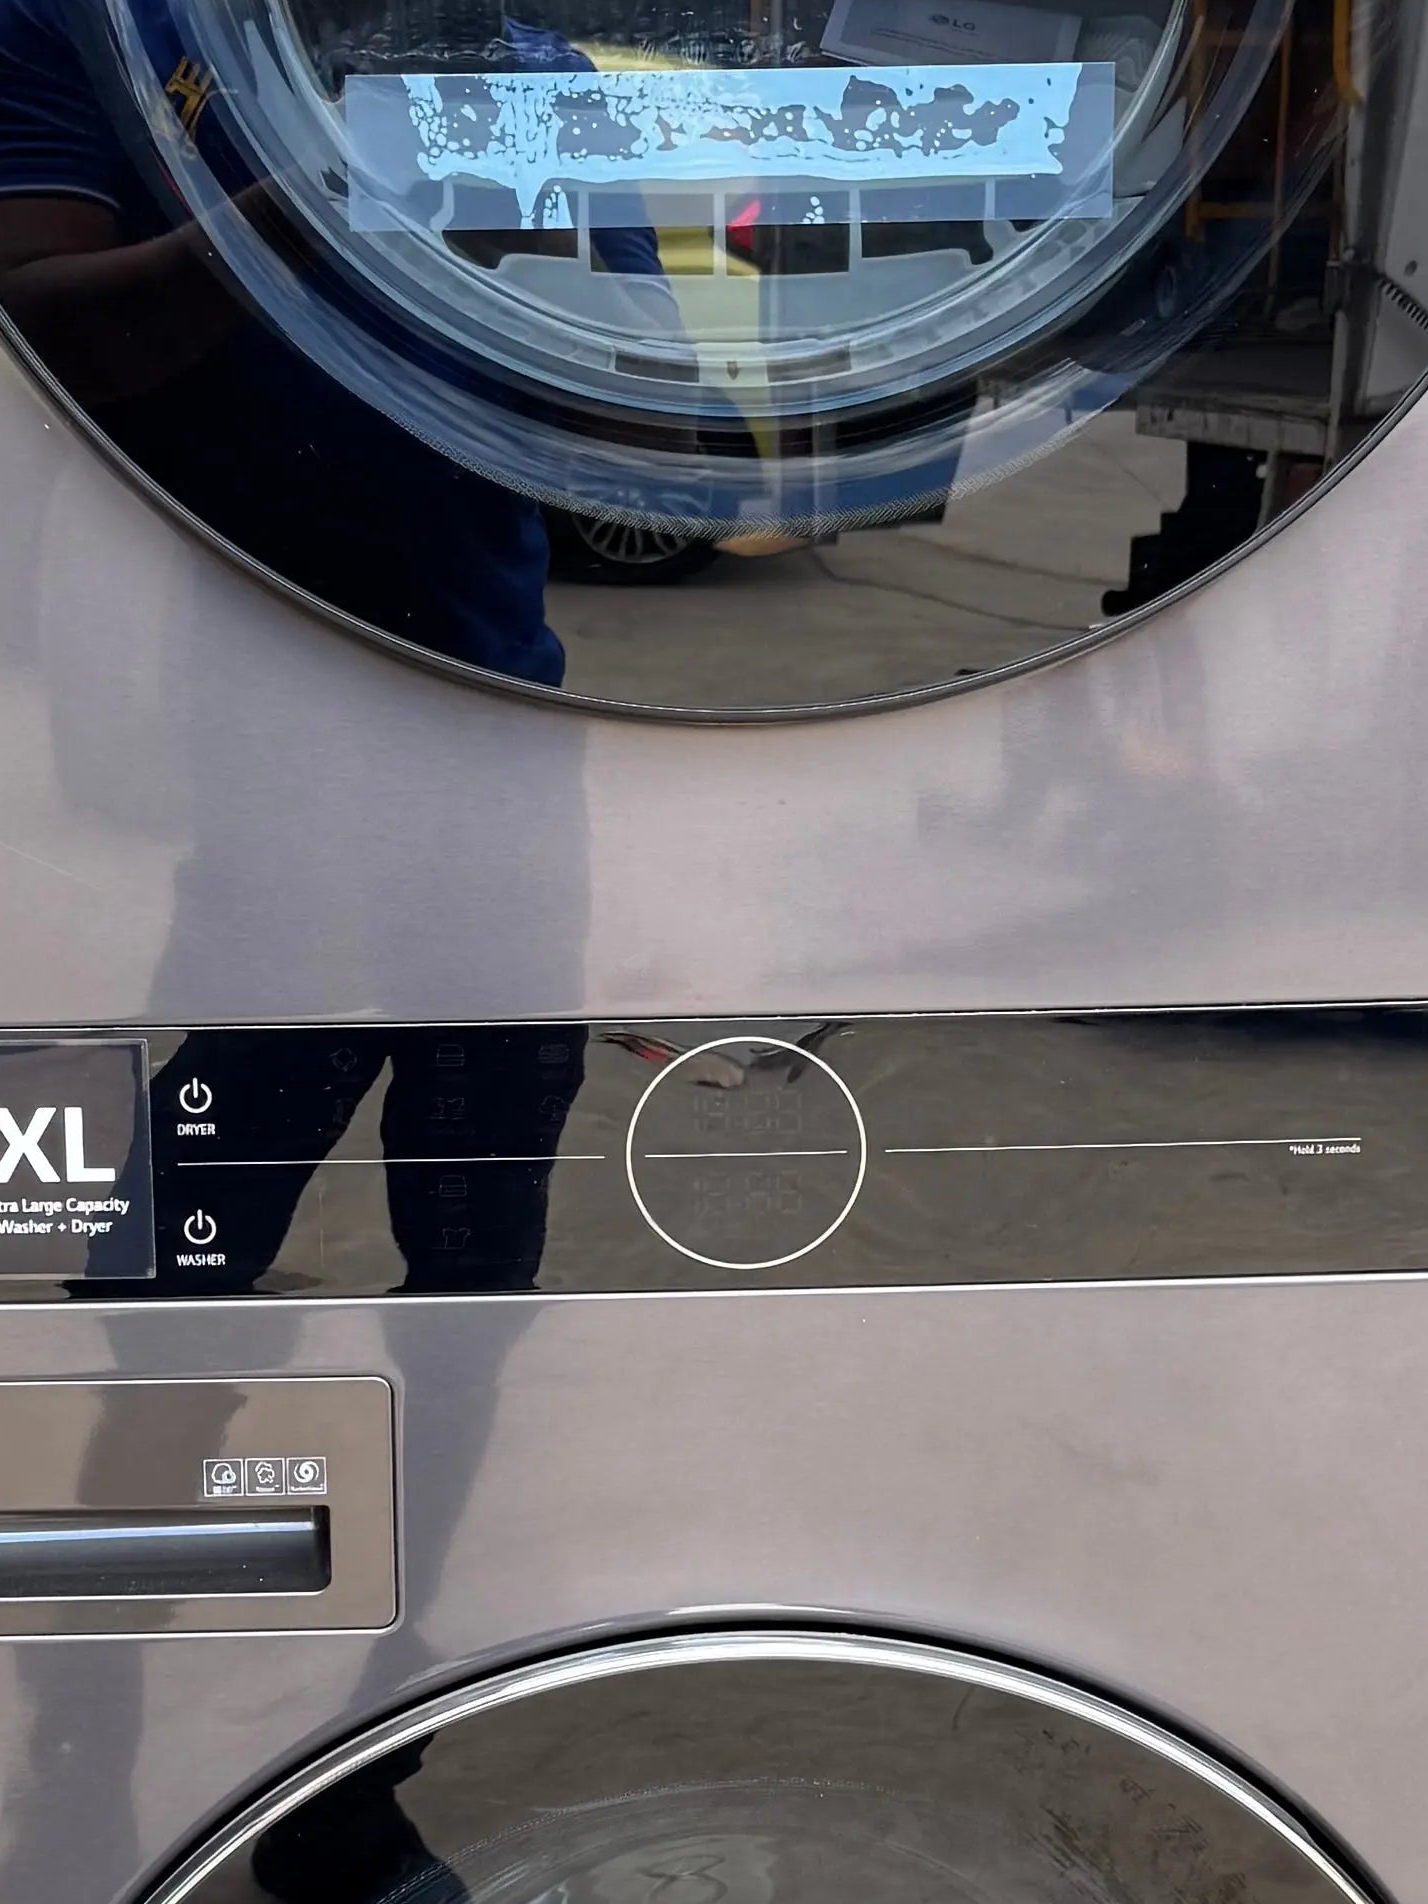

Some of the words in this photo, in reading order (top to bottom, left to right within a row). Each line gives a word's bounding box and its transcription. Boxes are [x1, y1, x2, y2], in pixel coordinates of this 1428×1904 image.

[176, 1122, 216, 1137] DRYER
[1325, 1143, 1361, 1154] seconds
[21, 1198, 63, 1217] Large
[65, 1197, 130, 1215] Capacity
[70, 1217, 114, 1235] Dryer
[176, 1253, 227, 1267] WASHER
